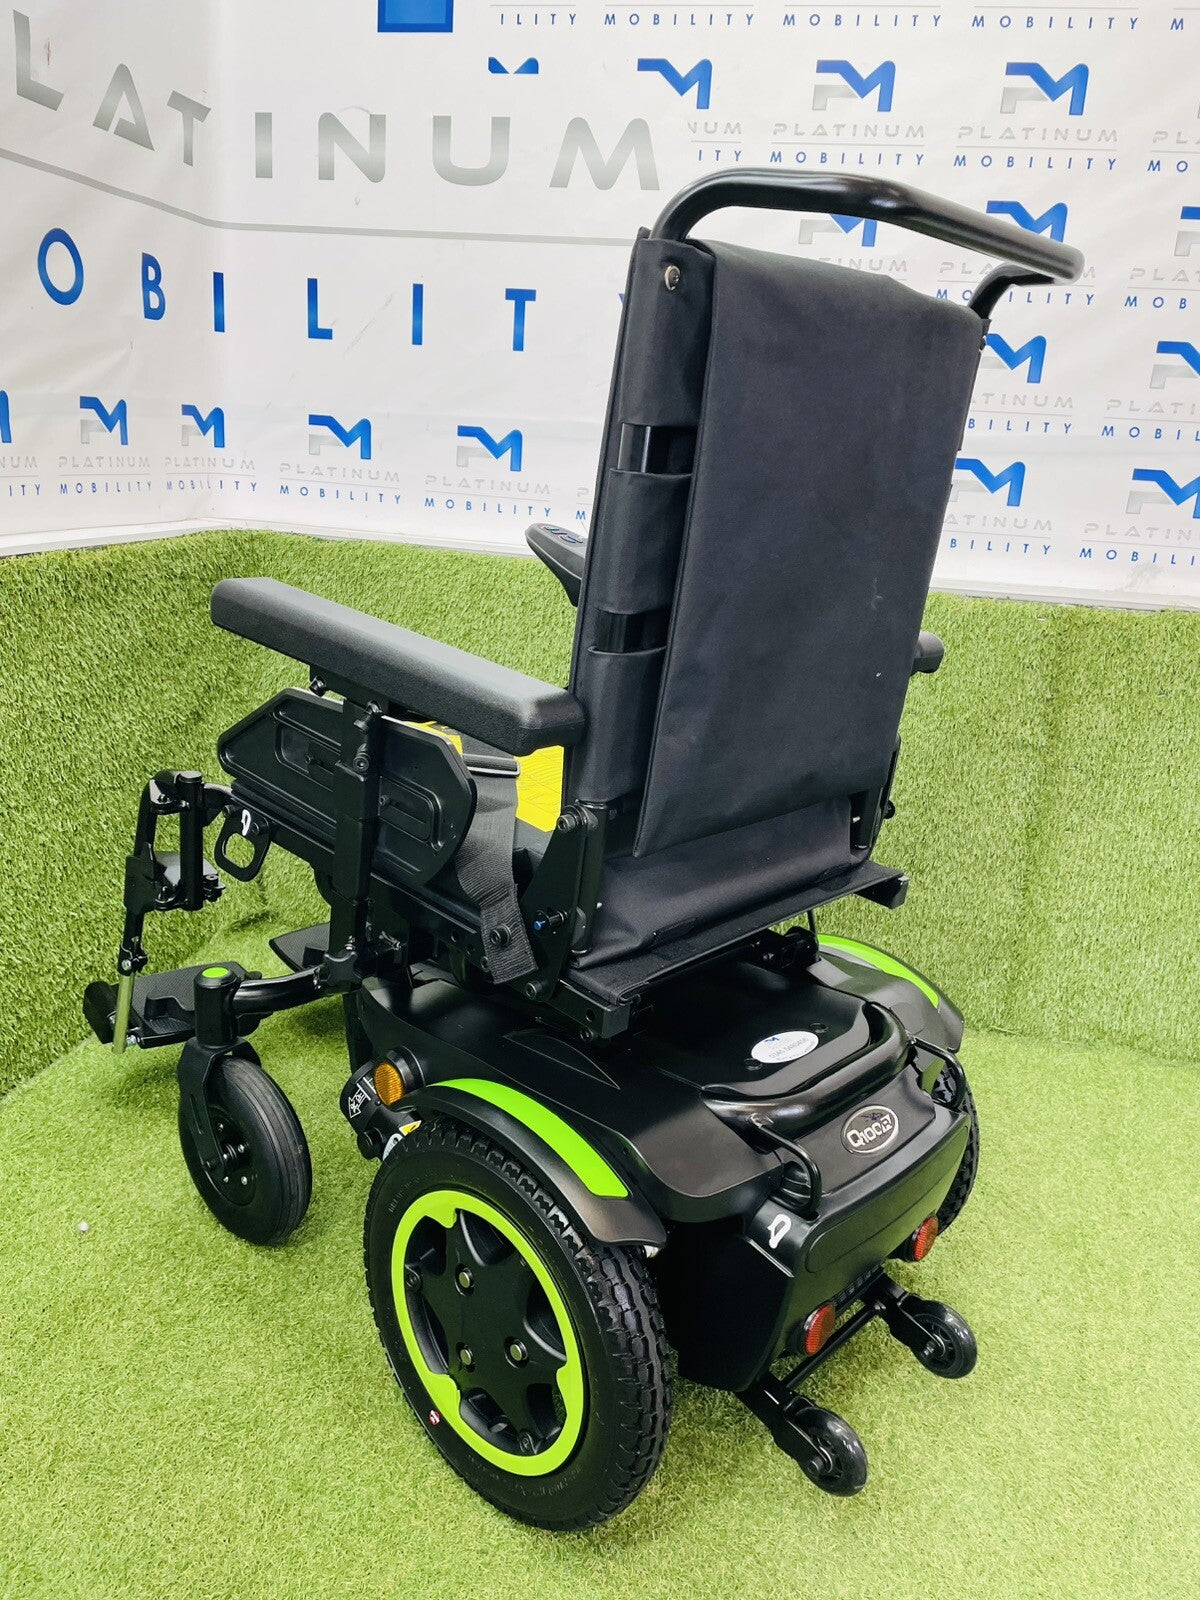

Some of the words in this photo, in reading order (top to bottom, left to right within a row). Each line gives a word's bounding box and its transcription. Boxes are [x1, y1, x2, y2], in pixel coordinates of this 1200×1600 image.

[604, 13, 754, 27] MOBILITY
[783, 13, 941, 28] MOBILITY
[971, 15, 1138, 31] MOBILITY
[772, 122, 926, 139] PLATINUM
[957, 125, 1118, 143] PLATINUM
[769, 150, 926, 166] MOBILITY
[953, 153, 1117, 171] MOBILITY
[37, 226, 625, 352] OBILIT
[58, 455, 150, 468] PLATINUM
[164, 456, 255, 470] PLATINUM
[280, 462, 400, 482] PLATINUM
[59, 480, 152, 495] MOBILITY
[166, 479, 257, 492] MOBILITY
[425, 474, 551, 495] PLATINUM
[279, 484, 401, 504] MOBILITY
[424, 497, 551, 517] MOBILITY
